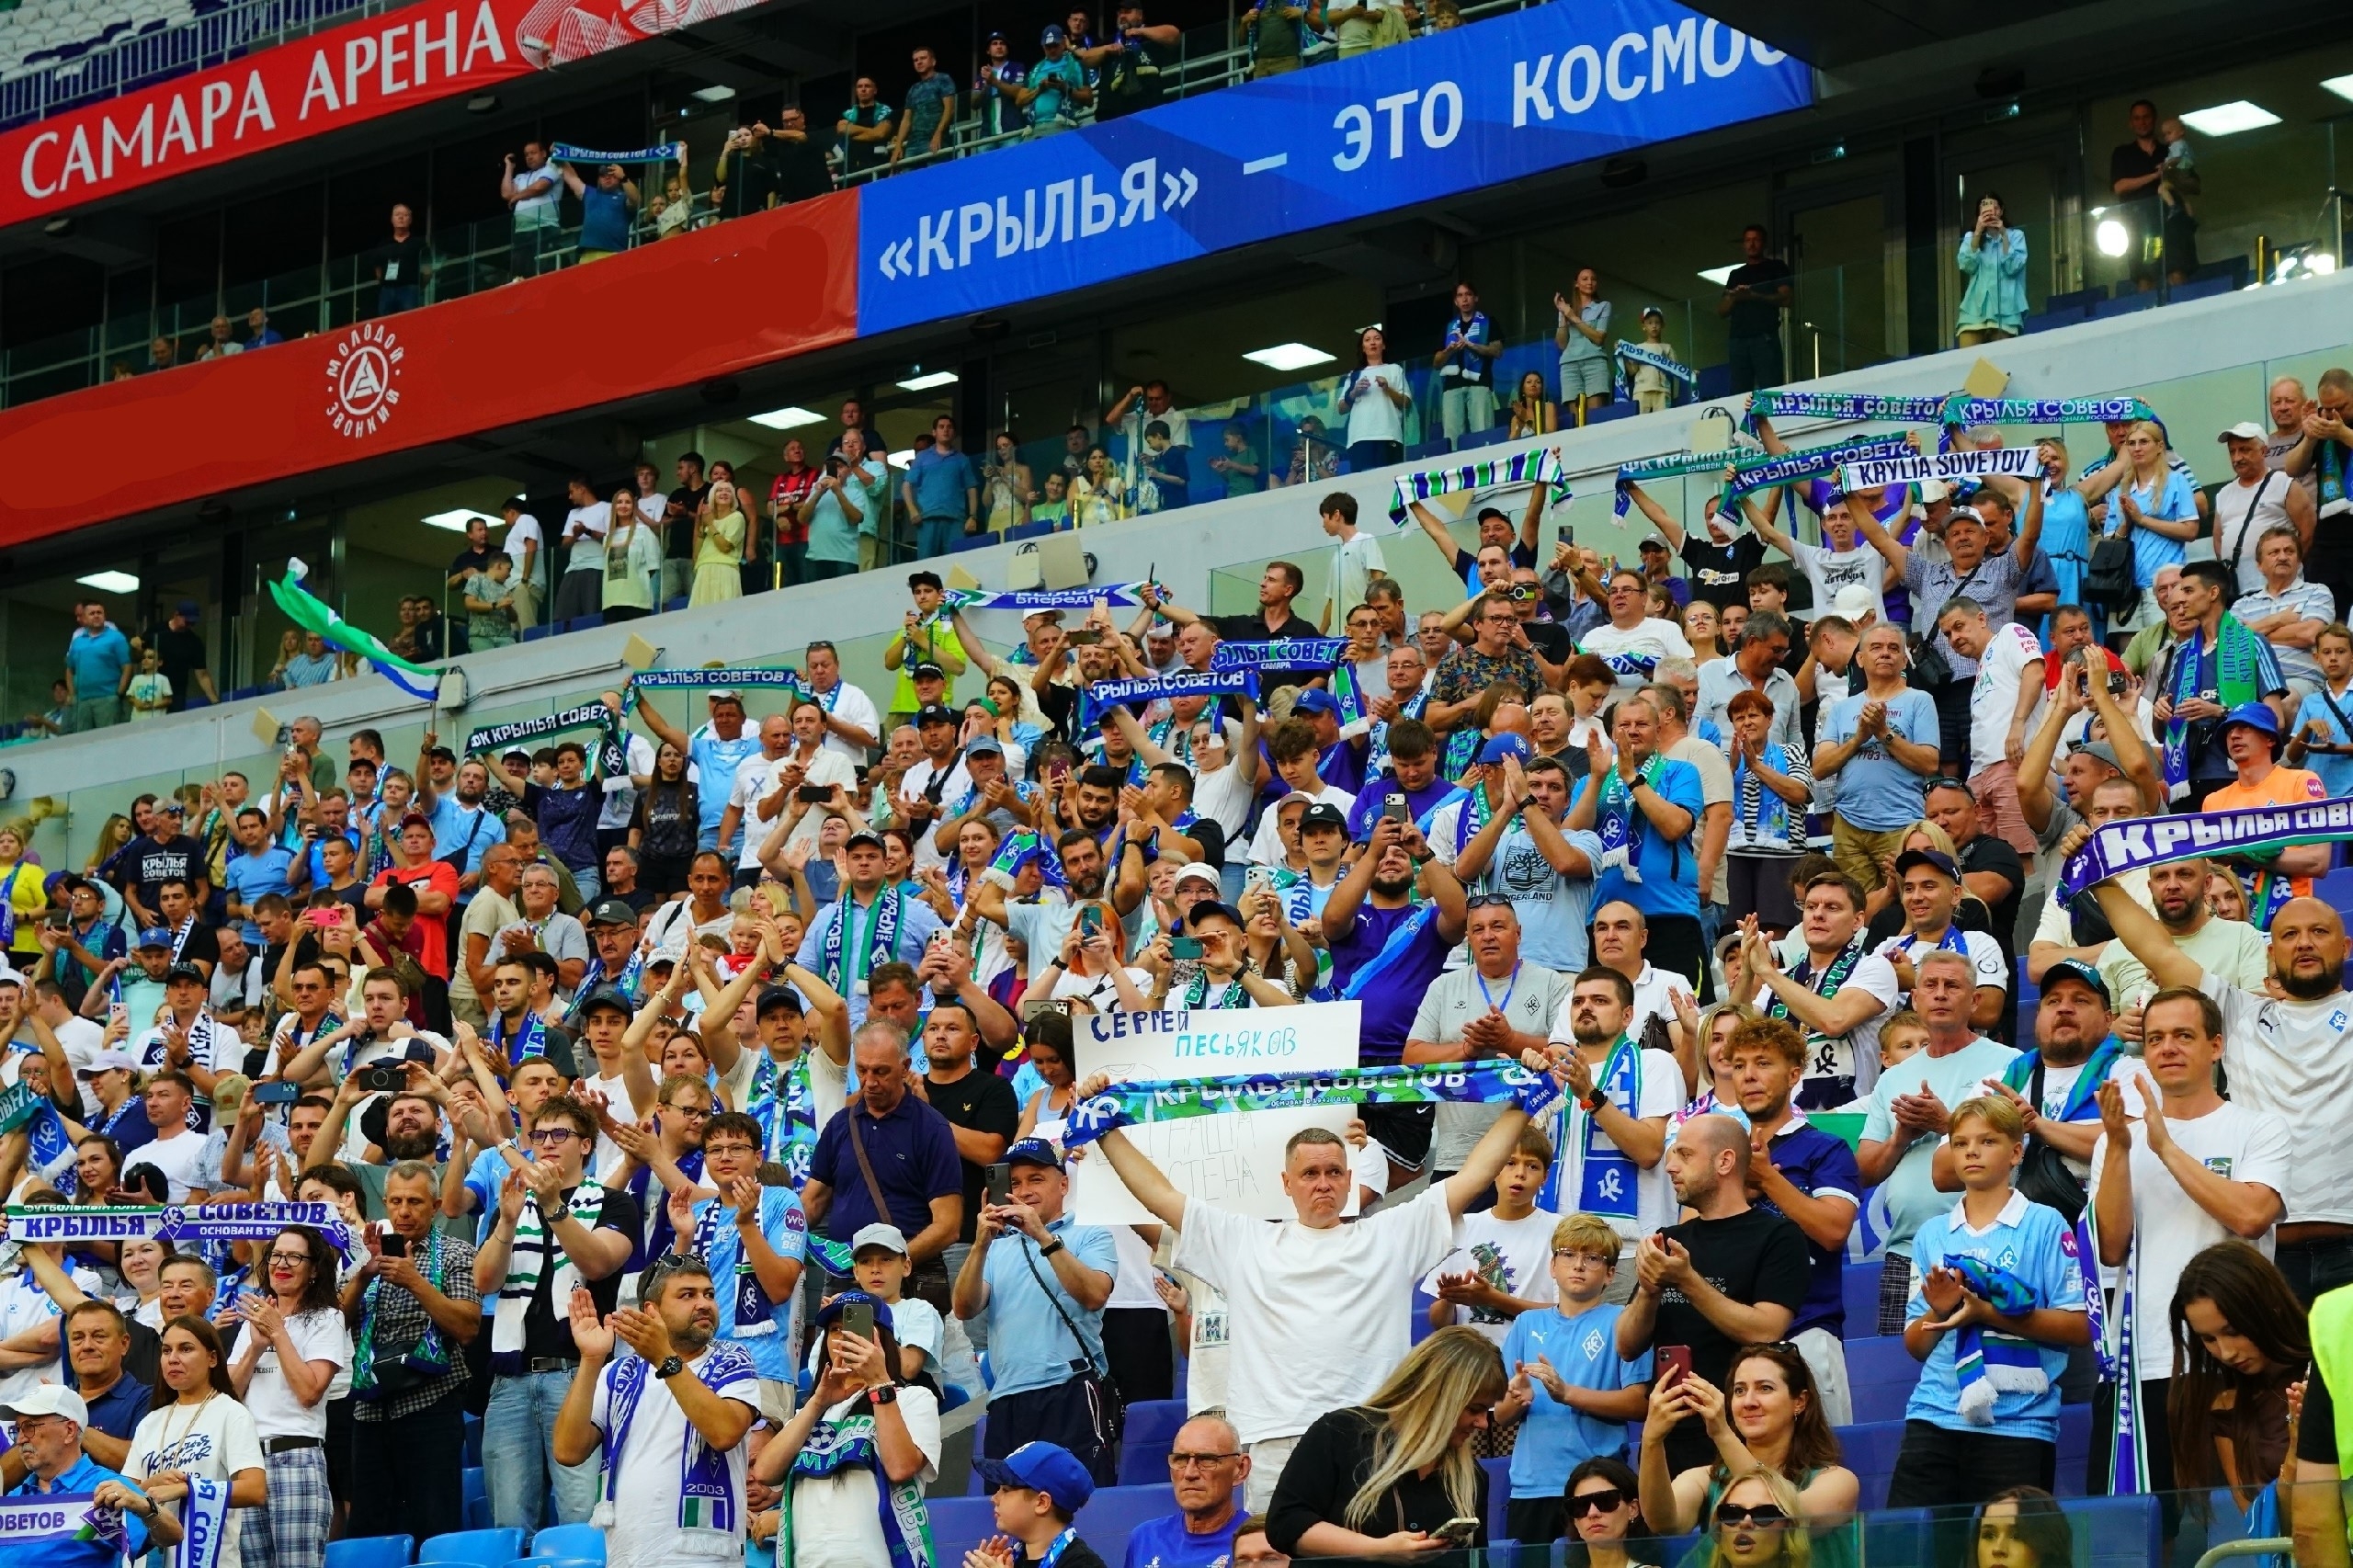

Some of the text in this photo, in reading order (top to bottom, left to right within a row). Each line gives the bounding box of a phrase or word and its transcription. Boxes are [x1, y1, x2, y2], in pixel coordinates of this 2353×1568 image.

[20, 0, 506, 199] САМАРА АРЕНА
[880, 158, 1199, 281] «КРЫЛЬЯ»
[1333, 80, 1463, 173] ЭТО
[326, 324, 404, 377] МОЛОДОЙ
[326, 388, 400, 438] ЗВОНКИЙ
[1771, 396, 1936, 416] КРЫЛЬЯ СОВЕТО
[1959, 401, 2134, 420] КРЫЛЬЯ СОВЕТОВ
[1740, 440, 1909, 487] КРЫЛЬЯ СОВЕТО
[1859, 449, 2030, 485] KRYLIA SOVETOV
[1276, 641, 1342, 664] СОВЕТ
[1260, 661, 1291, 670] САМАРА
[638, 671, 785, 686] КРЫЛЬЯ СОВЕТОВ
[1163, 669, 1245, 692] СОВЕТОВ
[470, 732, 491, 748] ФК
[491, 714, 556, 744] КРЫЛЬЯ
[2099, 801, 2353, 869] КРЫЛЬЯ СОВ
[142, 857, 188, 870] КРЫЛЬЯ
[142, 868, 187, 879] СОВЕТОВ
[875, 934, 892, 942] 1942
[825, 950, 841, 959] 1942
[1091, 1010, 1189, 1042] СЕРГЕЙ
[1176, 1027, 1297, 1058] ПЕСЬЯКОВ
[1153, 1072, 1466, 1108] КРЫЛЬЯ СОВЕТОВ
[1168, 1155, 1260, 1201] СТЕНА
[25, 1202, 327, 1237] КРЫЛЬЯ СОВЕТОВ
[199, 1226, 253, 1235] ОСНОВАН
[256, 1226, 264, 1235] В
[786, 1213, 805, 1227] wb
[781, 1232, 803, 1244] FON
[781, 1242, 802, 1252] BET
[794, 1439, 872, 1471] МАРА
[685, 1483, 726, 1495] 2003
